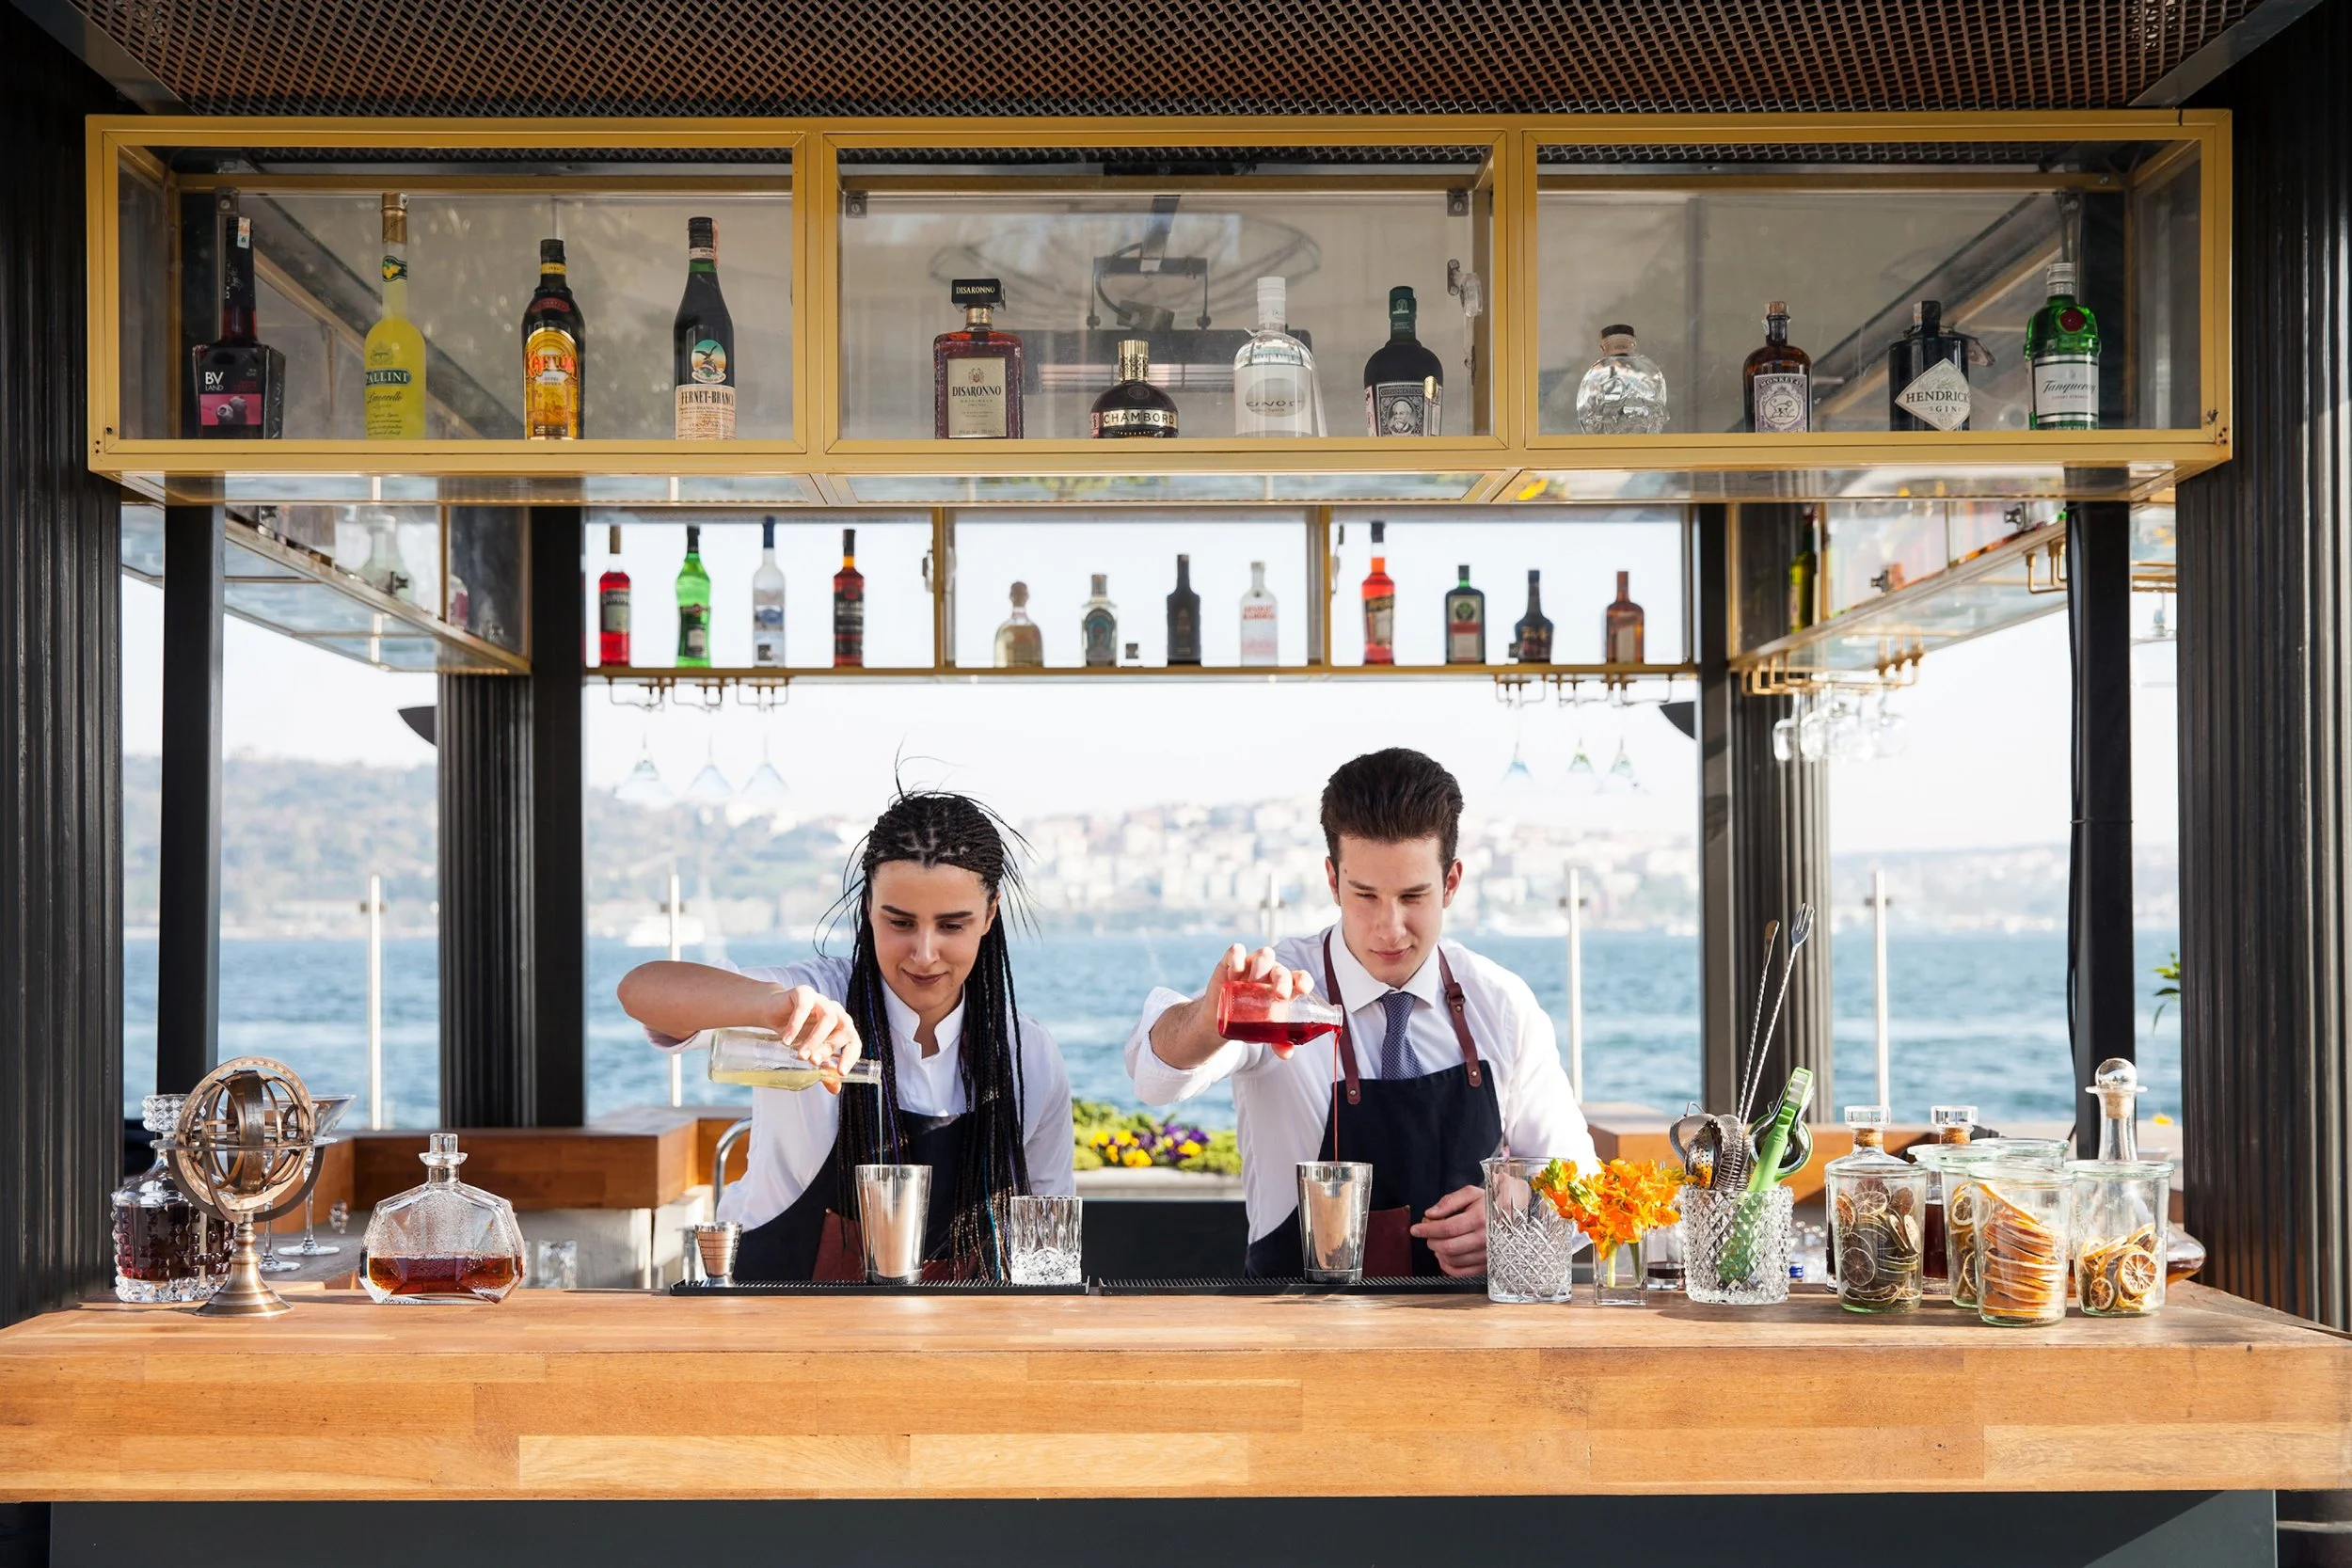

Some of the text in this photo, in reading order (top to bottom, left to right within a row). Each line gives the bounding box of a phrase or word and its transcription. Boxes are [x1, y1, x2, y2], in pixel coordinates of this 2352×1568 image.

[956, 286, 994, 294] DISARONNO
[205, 372, 224, 384] BV
[366, 372, 407, 383] ALLINI
[952, 386, 1001, 397] DISARONNO
[1104, 412, 1175, 424] CHAMBORD
